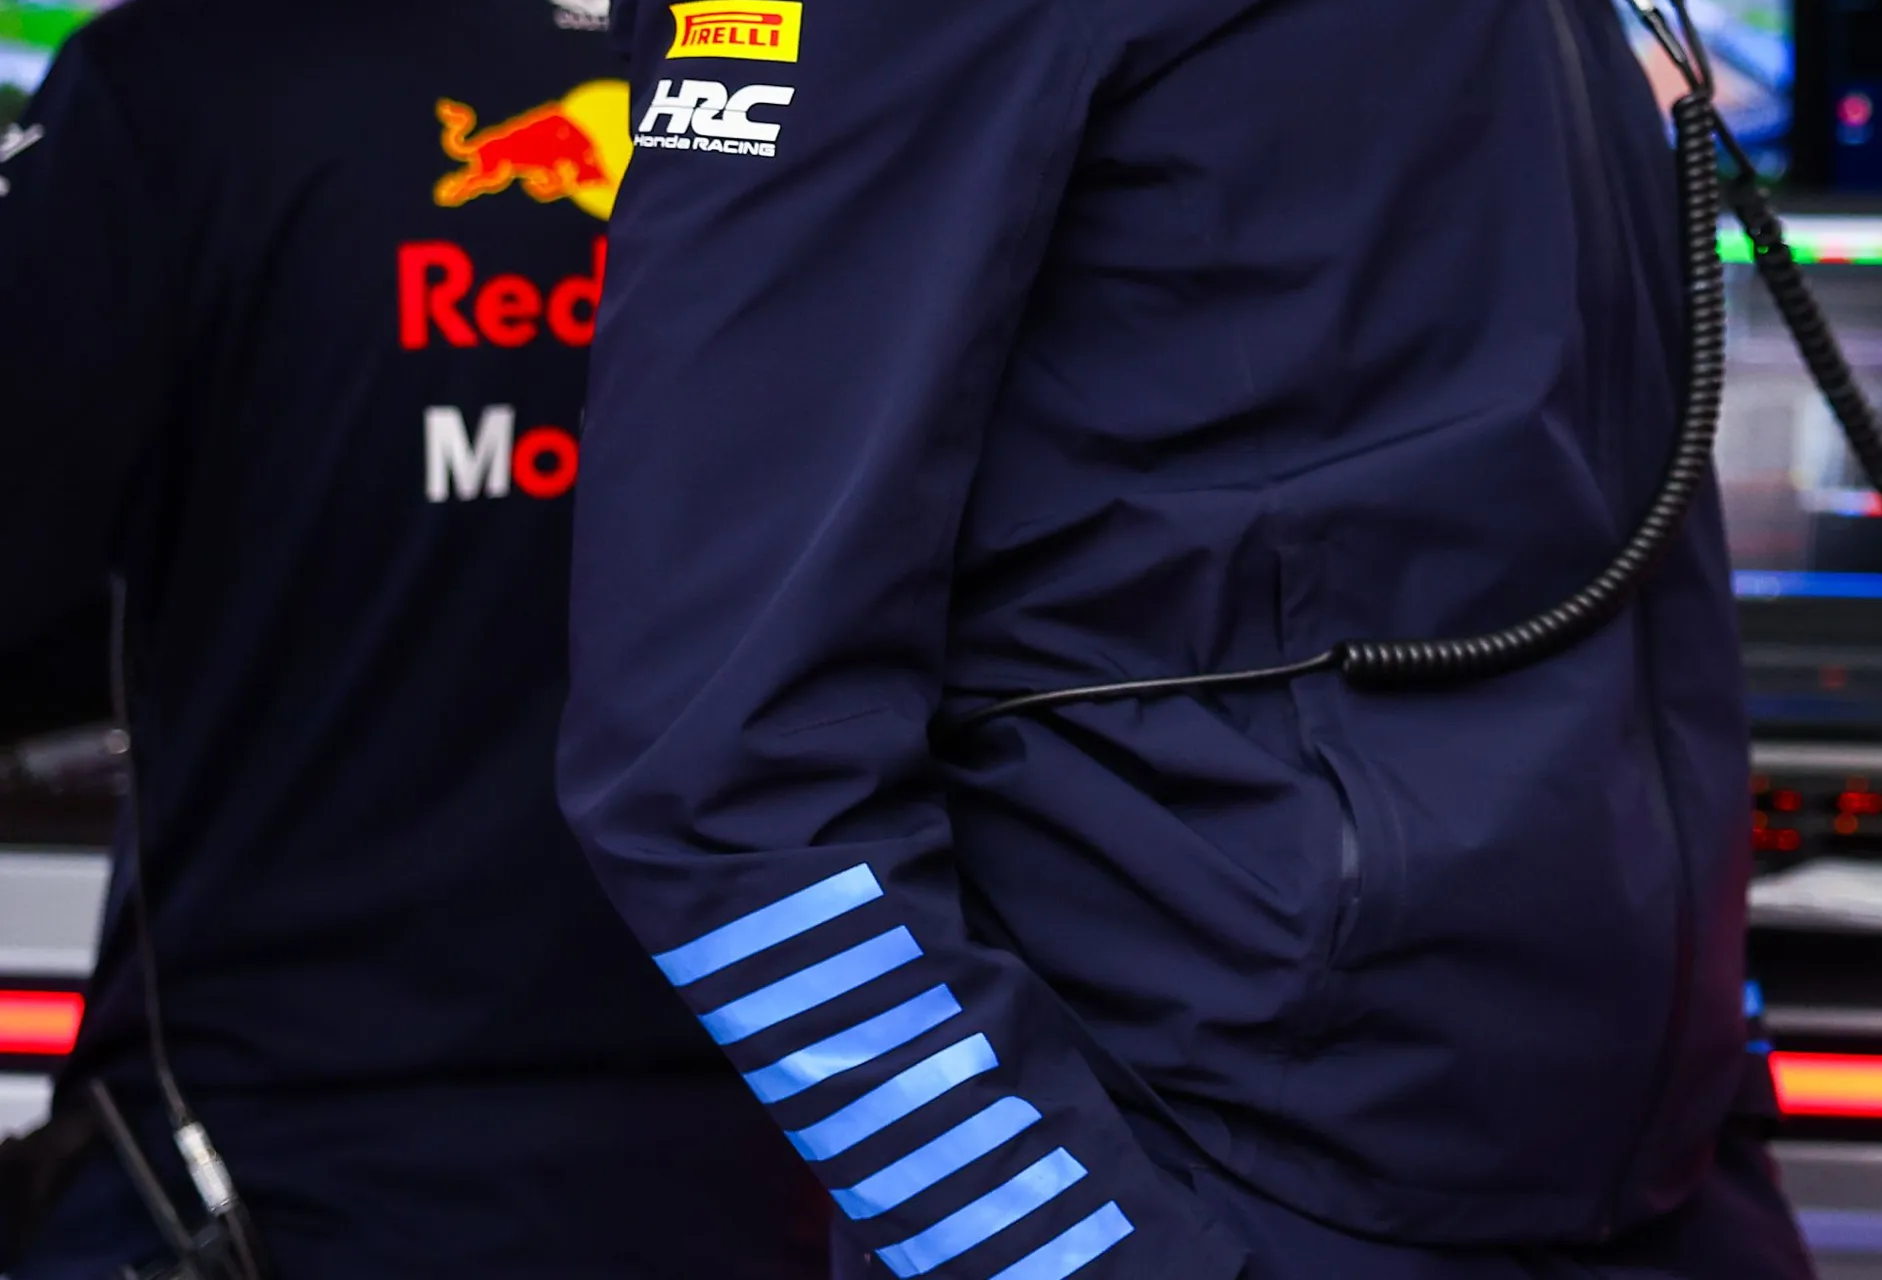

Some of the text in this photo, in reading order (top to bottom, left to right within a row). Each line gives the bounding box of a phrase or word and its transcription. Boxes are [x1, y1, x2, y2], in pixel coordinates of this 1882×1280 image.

[681, 11, 783, 47] PIRELLI
[638, 78, 795, 142] HRC
[633, 133, 776, 157] Honda RACING
